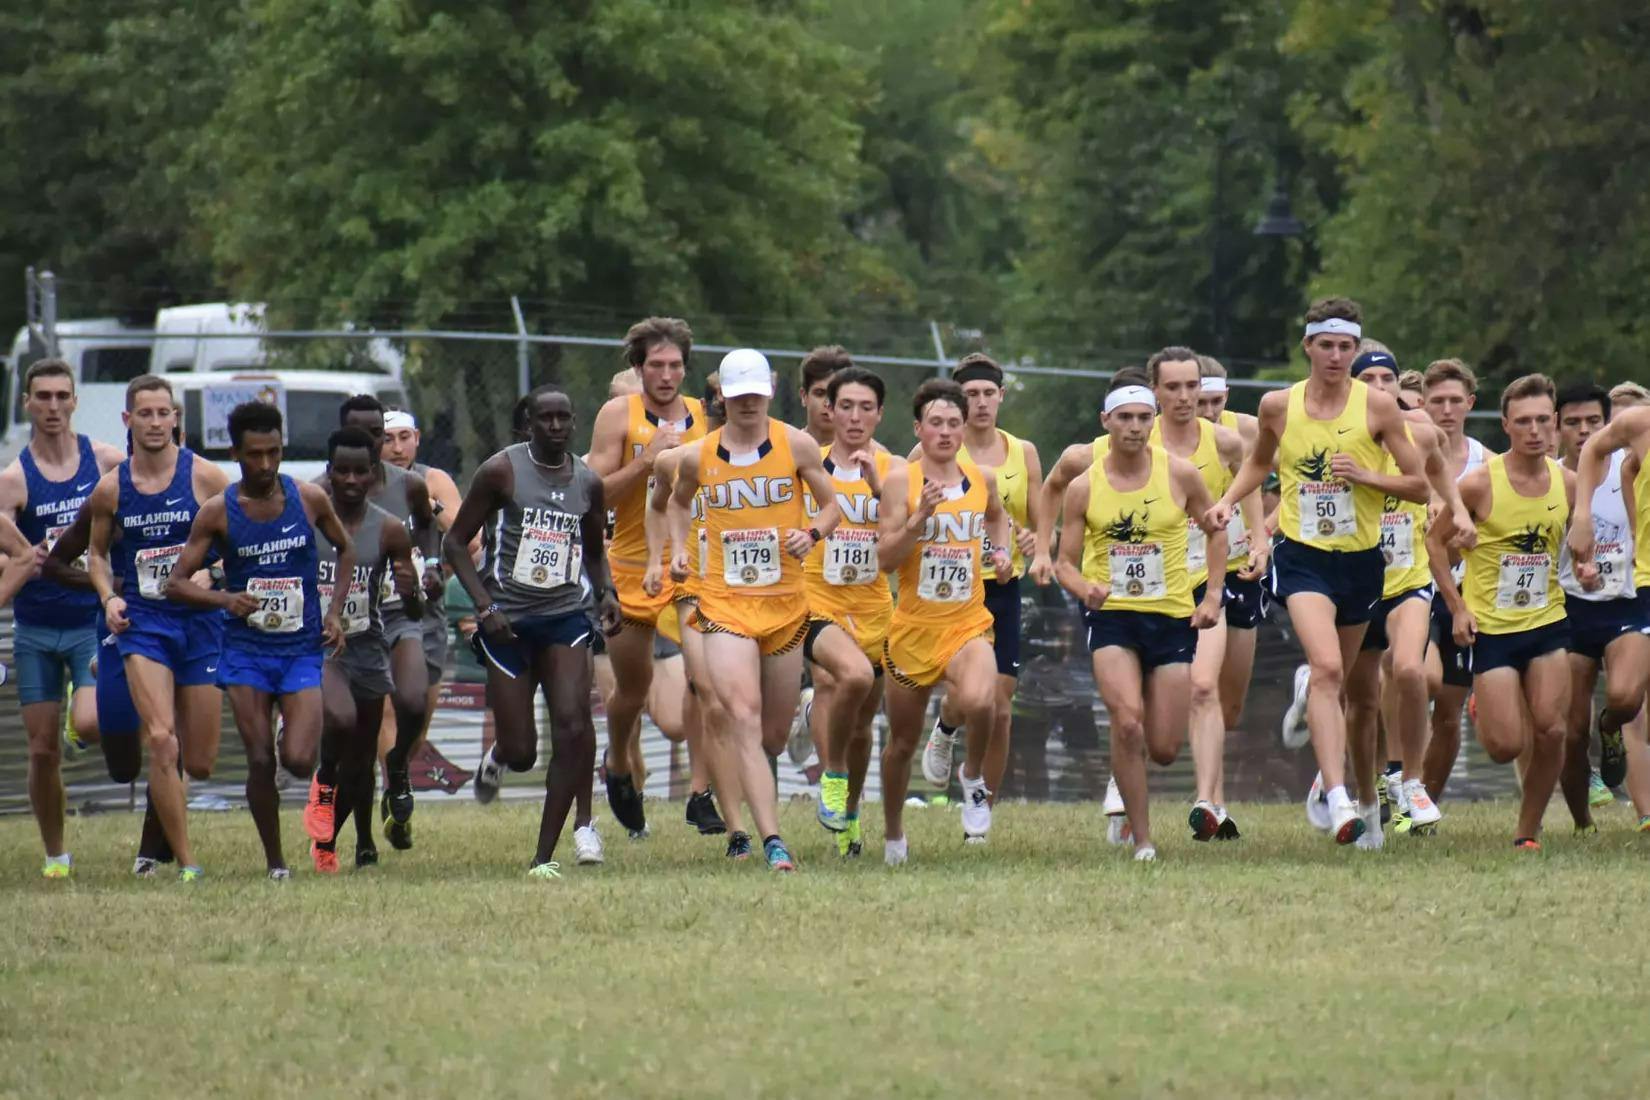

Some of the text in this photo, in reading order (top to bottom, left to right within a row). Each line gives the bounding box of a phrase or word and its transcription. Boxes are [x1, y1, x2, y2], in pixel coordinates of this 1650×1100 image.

[701, 476, 793, 511] UNC
[1316, 501, 1336, 517] 50
[57, 511, 78, 524] CIT
[123, 510, 191, 528] OKLAHOMA
[142, 524, 171, 537] CITY
[238, 535, 307, 556] OKLAHOMA
[258, 552, 288, 565] CITY
[530, 548, 559, 567] 369
[732, 548, 771, 565] 1179
[833, 548, 870, 564] 1181
[929, 566, 967, 582] 1178
[1125, 563, 1145, 579] 48
[1516, 573, 1535, 588] 47
[260, 597, 288, 612] 731
